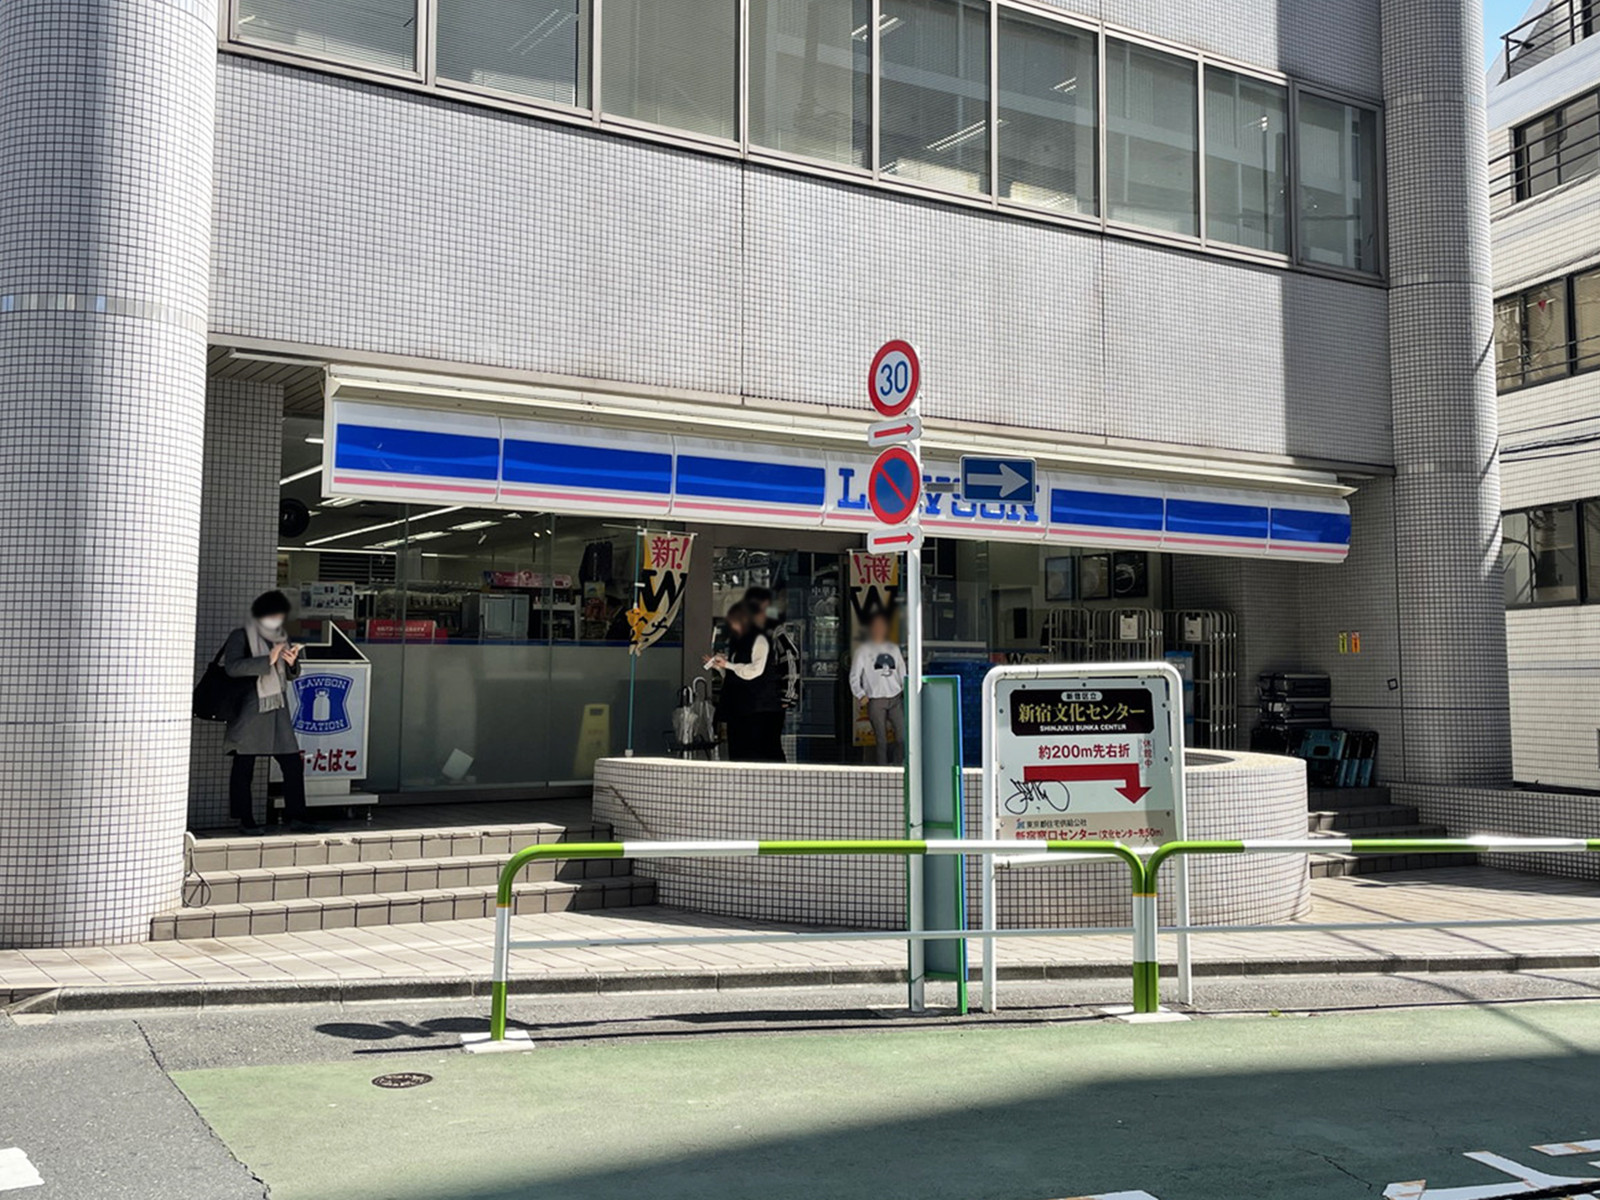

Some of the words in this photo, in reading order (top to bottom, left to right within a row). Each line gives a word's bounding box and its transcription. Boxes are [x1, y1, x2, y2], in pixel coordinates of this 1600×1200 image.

[879, 360, 908, 396] 30
[651, 536, 690, 570] 新!
[639, 569, 688, 613] W
[298, 678, 347, 690] LAWSON
[1018, 702, 1145, 723] 新宿文化センター
[296, 718, 345, 731] STATION
[1039, 724, 1075, 732] SHINJUKU
[1038, 743, 1130, 760] 約200m先右折
